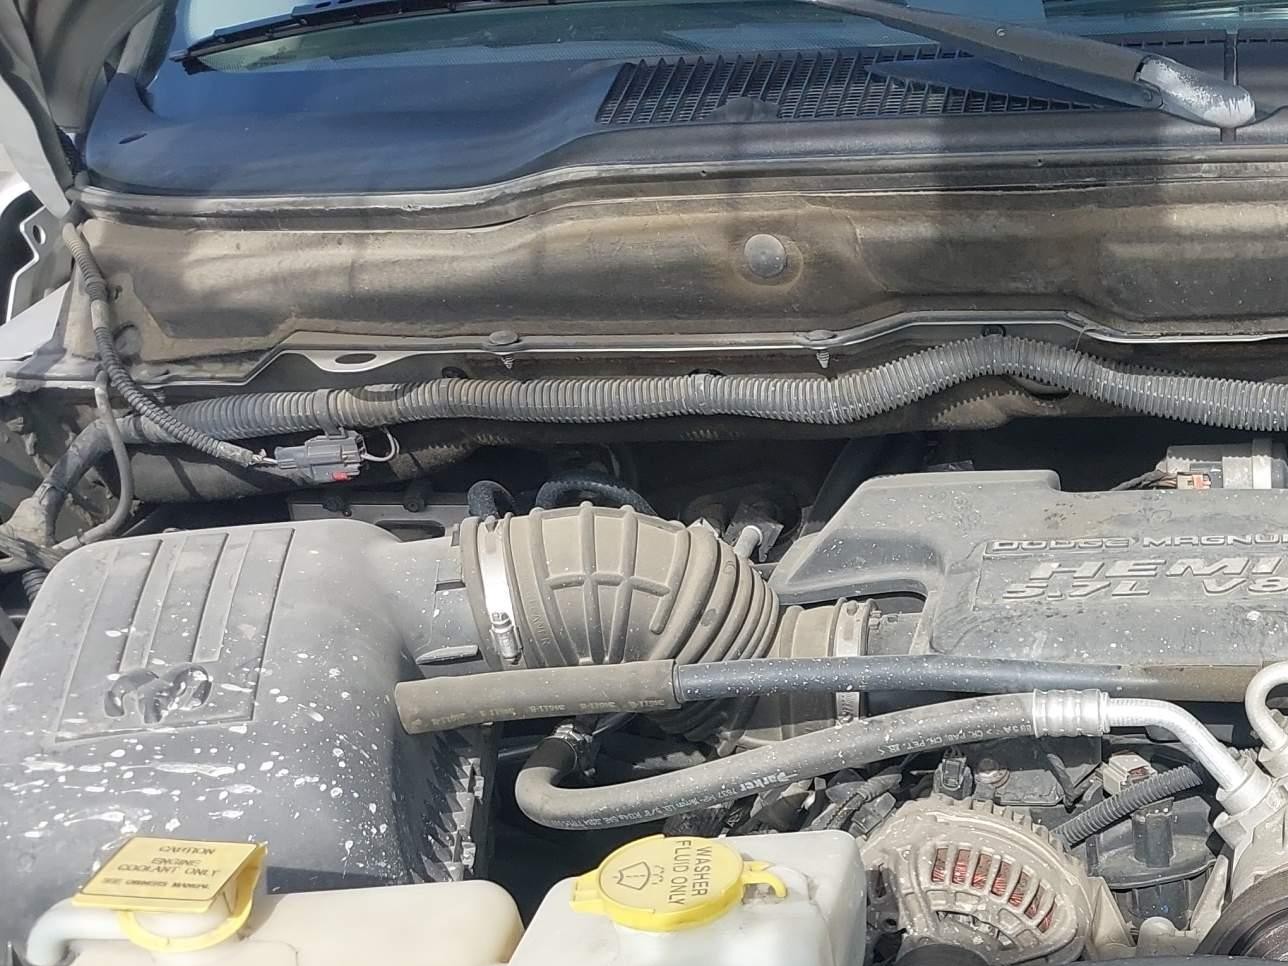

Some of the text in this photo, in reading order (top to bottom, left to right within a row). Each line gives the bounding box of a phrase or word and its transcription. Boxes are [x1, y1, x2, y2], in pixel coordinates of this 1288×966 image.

[991, 537, 1132, 551] DODGE
[1028, 556, 1283, 581] HEMI
[1002, 579, 1151, 601] 5.7L
[159, 845, 216, 855] CAUTION
[117, 863, 223, 877] COOLANT ONLY
[151, 857, 203, 866] ENGINE
[668, 839, 692, 905] FLUID ONLY
[691, 846, 713, 897] WASHER
